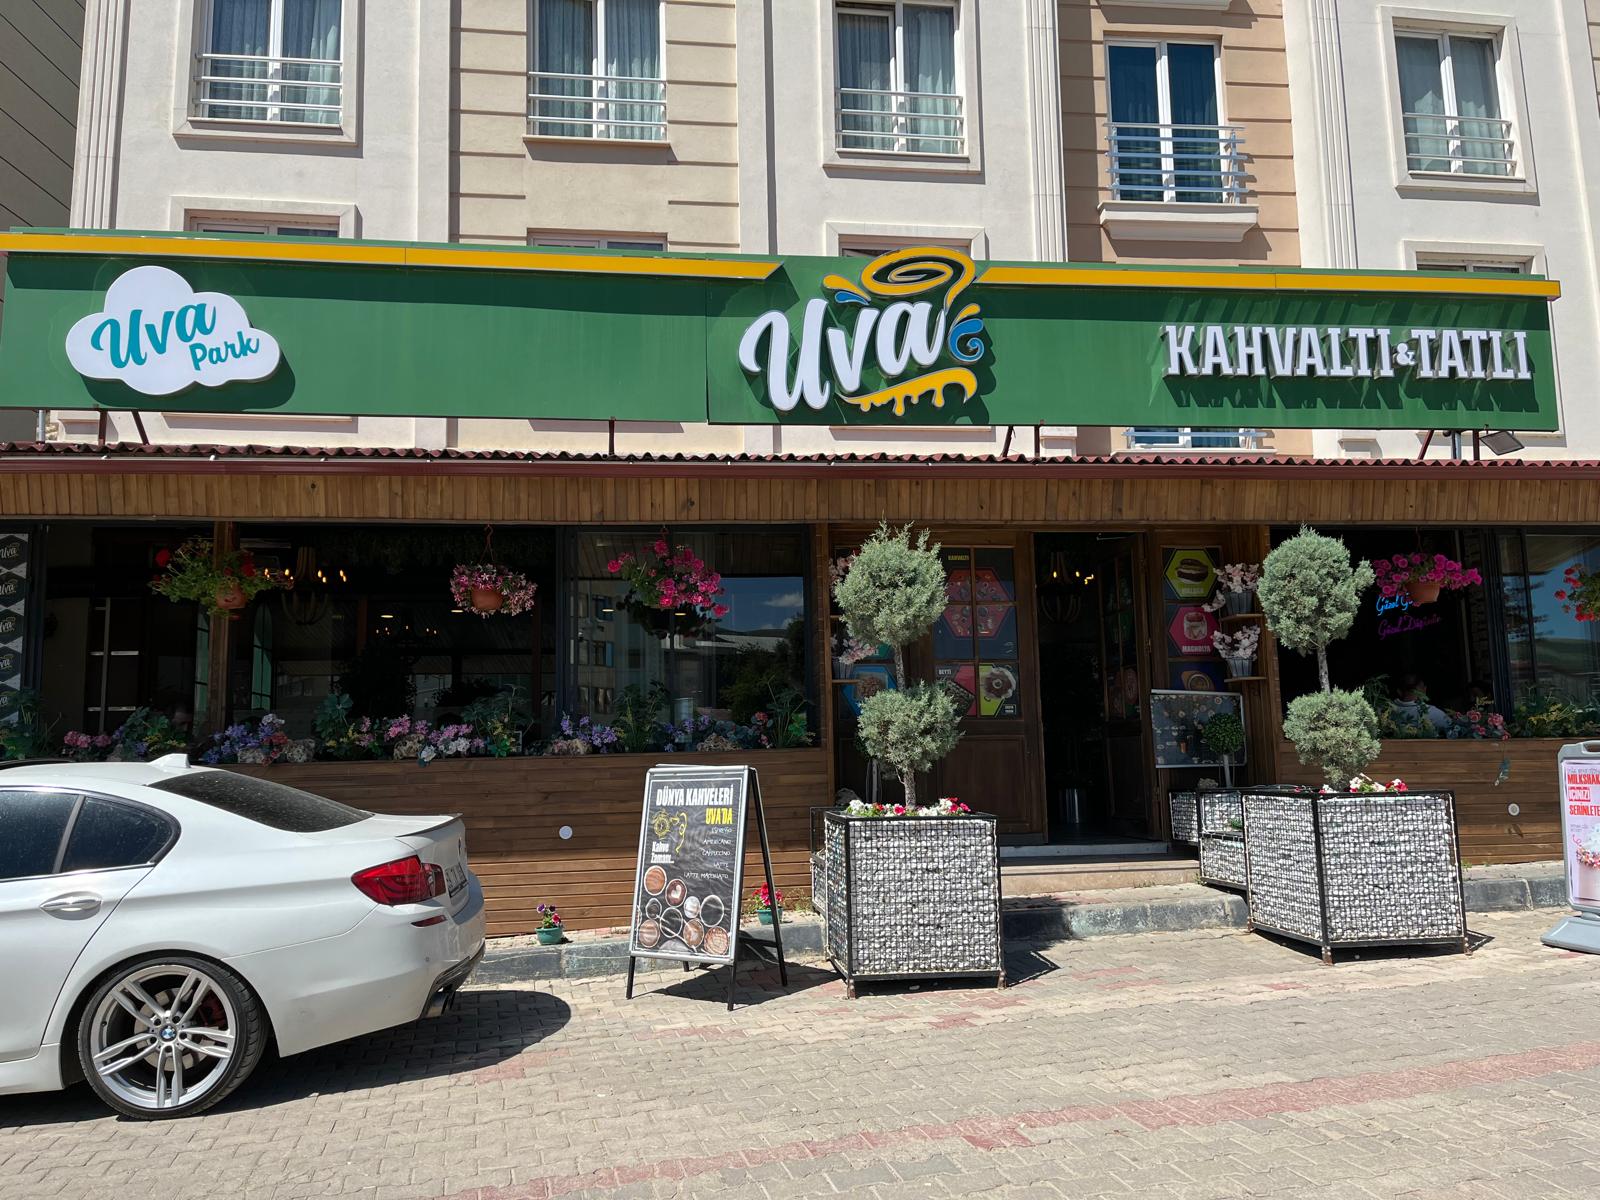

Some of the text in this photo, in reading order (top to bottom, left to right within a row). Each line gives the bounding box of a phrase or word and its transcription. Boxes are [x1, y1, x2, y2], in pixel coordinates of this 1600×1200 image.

[90, 303, 216, 369] Uva
[189, 331, 260, 371] Park
[739, 298, 946, 411] Uva
[1164, 325, 1394, 379] KAHVALTI
[1410, 328, 1532, 380] TATLI
[656, 784, 734, 806] DÜNYA KAHVELERİ
[652, 841, 669, 853] Kahve
